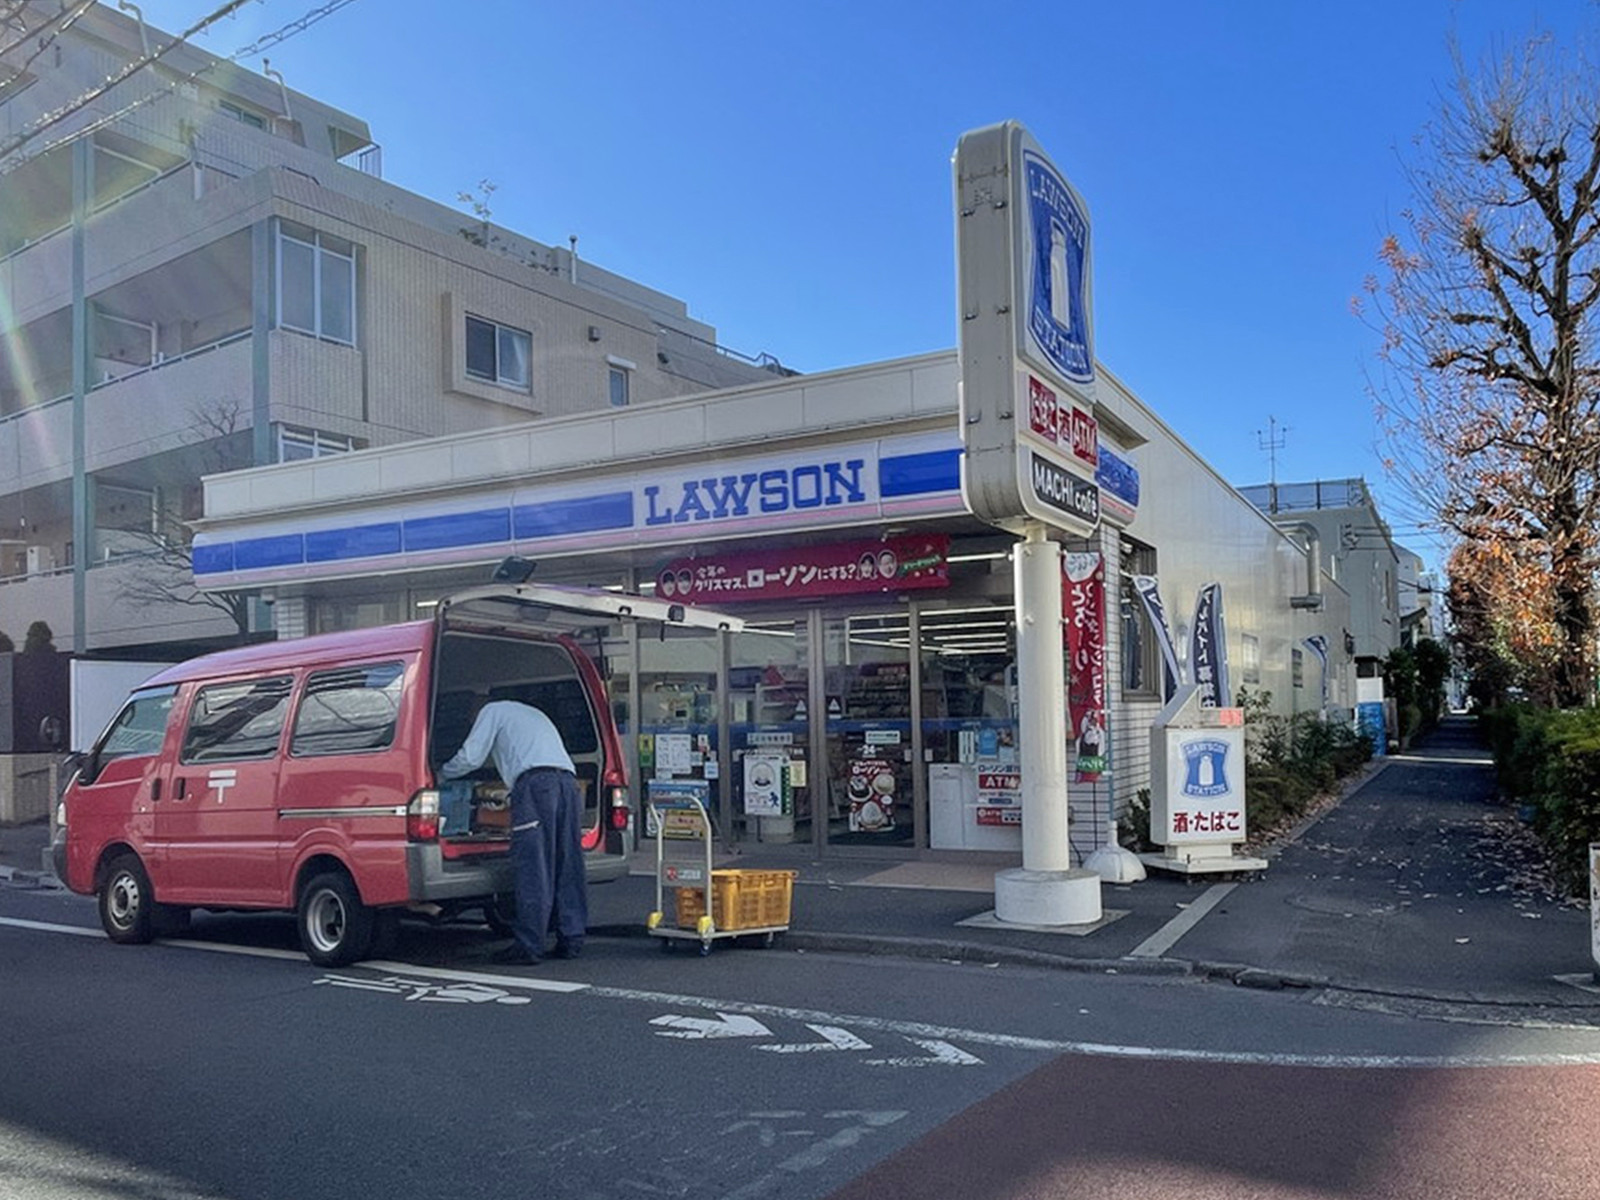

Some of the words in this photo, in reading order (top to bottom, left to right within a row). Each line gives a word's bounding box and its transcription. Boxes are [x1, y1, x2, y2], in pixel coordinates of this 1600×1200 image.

[1030, 169, 1084, 249] LAWSON
[1034, 304, 1088, 369] STATION
[1031, 389, 1056, 433] たばこ
[1073, 417, 1097, 455] ATM
[644, 458, 866, 526] LAWSON
[1034, 462, 1074, 506] MACHI
[1185, 742, 1227, 754] LAWSON
[985, 775, 1018, 788] ATM
[1187, 783, 1227, 796] STATION
